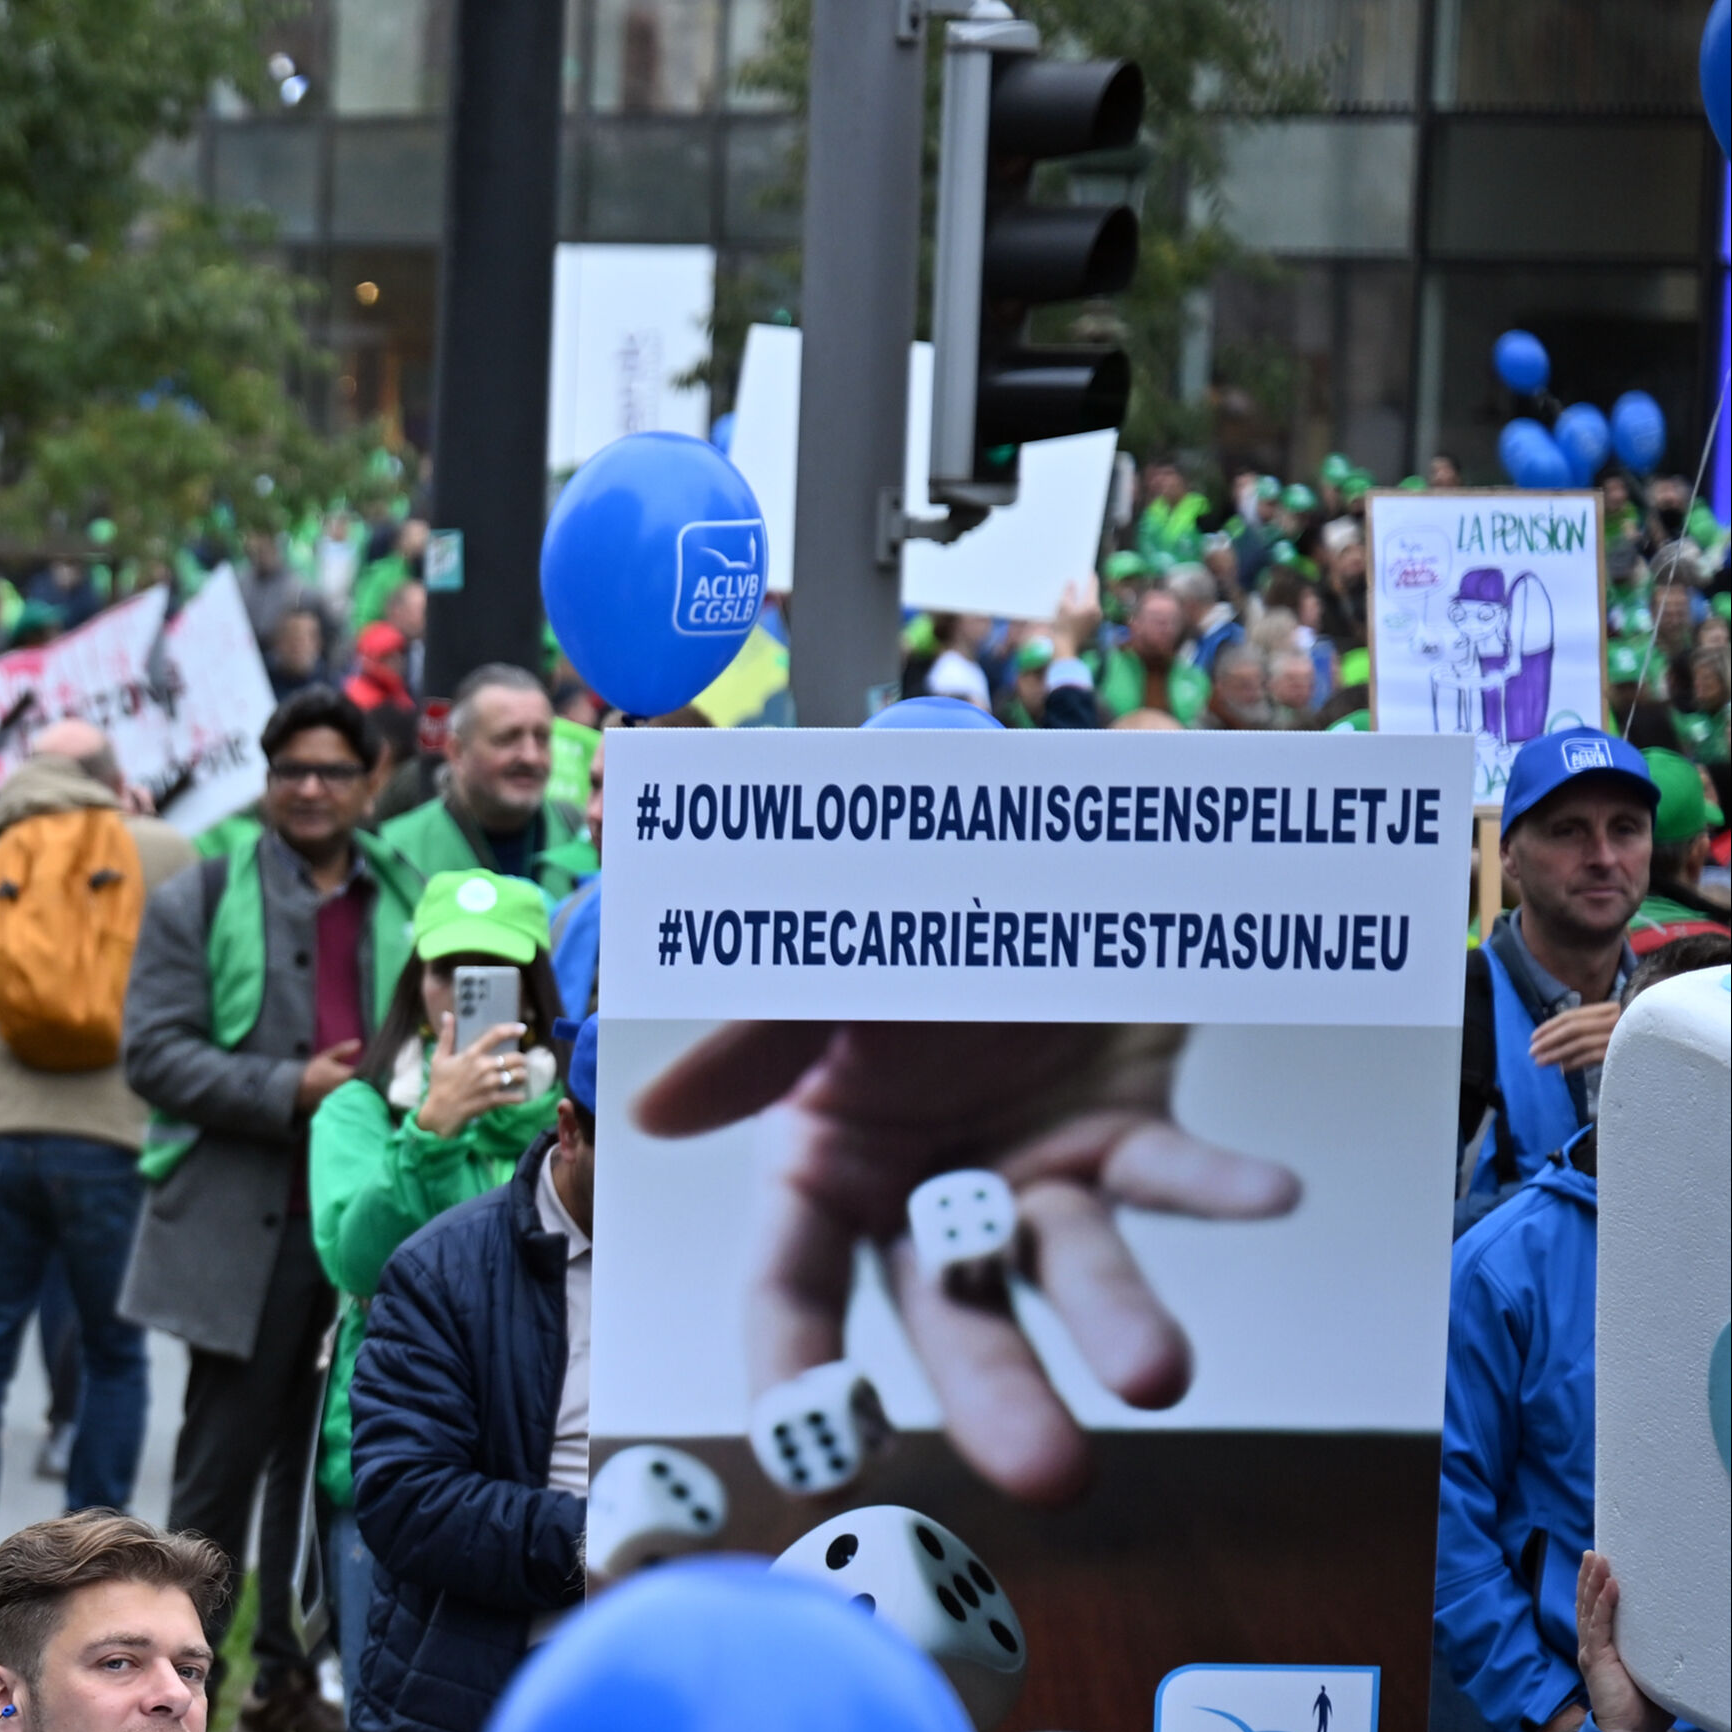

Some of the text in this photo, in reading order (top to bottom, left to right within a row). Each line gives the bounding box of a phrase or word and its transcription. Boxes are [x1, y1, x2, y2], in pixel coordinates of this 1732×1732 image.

[1457, 512, 1485, 554] LA
[694, 574, 760, 600] ACLVB
[689, 599, 756, 624] CGSLB
[637, 783, 1440, 845] #JOUWLOOPBAANISGEENSPELLETJE
[659, 898, 1410, 972] #VOTRECARRIÈREN'ESTPASUNJEU
